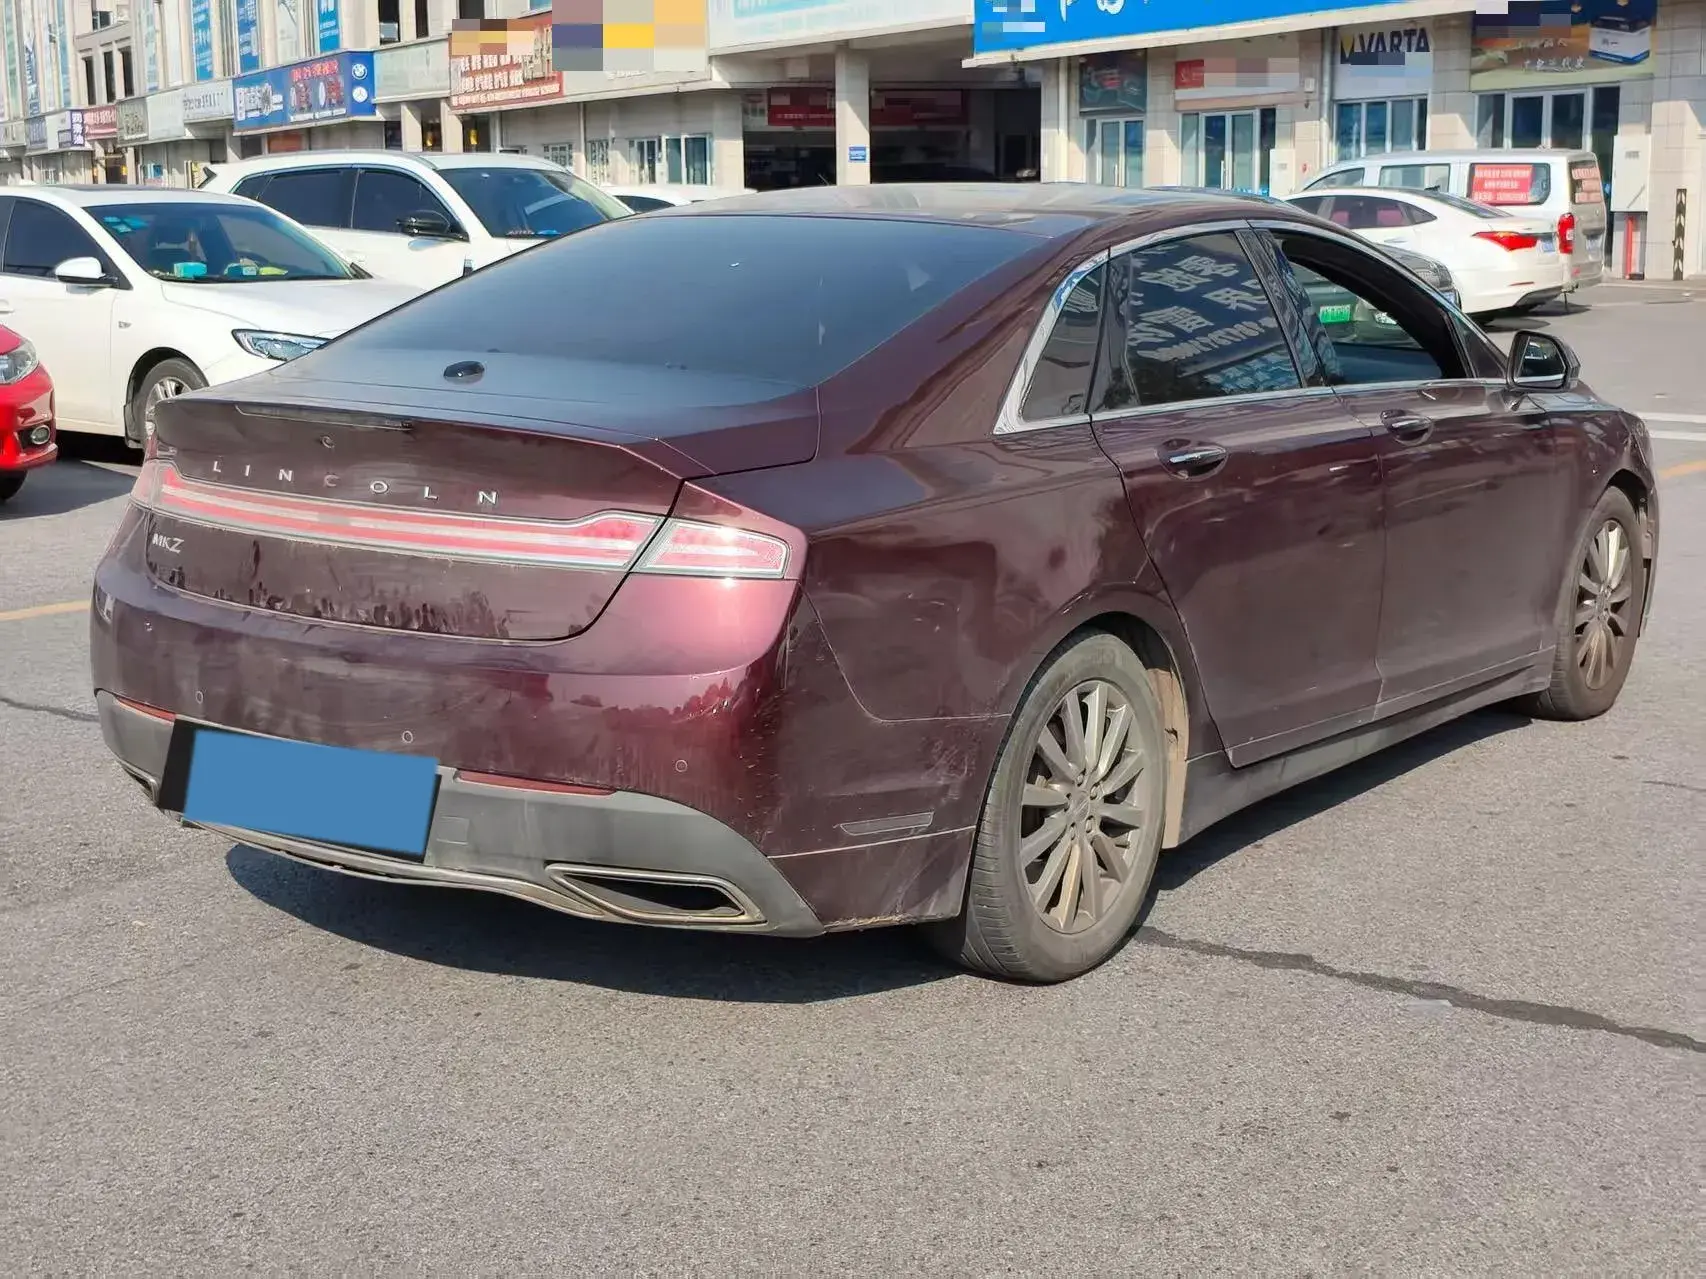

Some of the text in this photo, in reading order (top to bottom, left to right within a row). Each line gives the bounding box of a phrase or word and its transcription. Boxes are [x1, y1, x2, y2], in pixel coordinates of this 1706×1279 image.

[1358, 27, 1430, 53] VARTA
[213, 460, 498, 506] LINCOLN
[152, 533, 185, 554] MKZ
